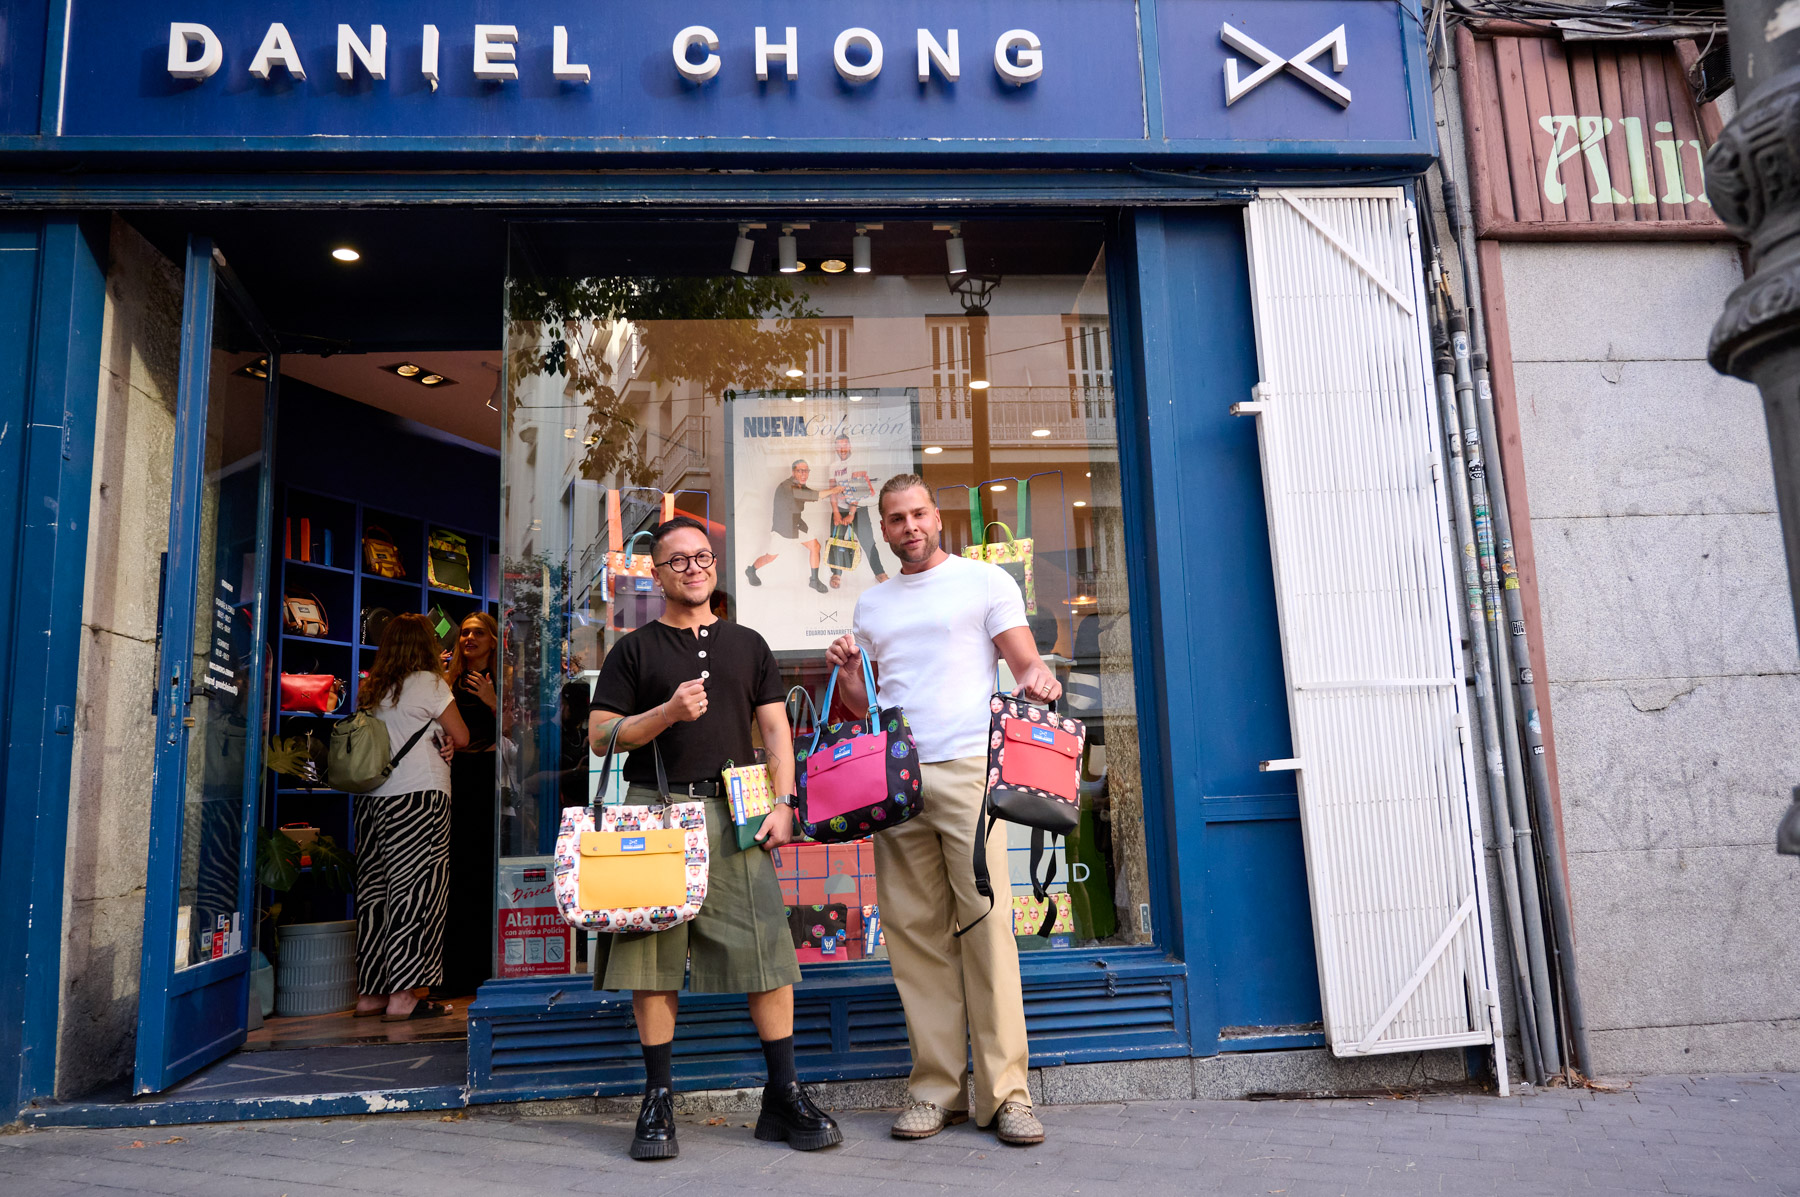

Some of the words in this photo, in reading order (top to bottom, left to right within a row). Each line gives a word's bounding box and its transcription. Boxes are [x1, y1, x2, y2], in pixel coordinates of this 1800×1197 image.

[167, 22, 591, 81] DANIEL
[672, 25, 1043, 84] CHONG
[743, 415, 807, 438] NUEVA
[804, 413, 906, 437] Colección
[805, 629, 827, 637] EDUARDO
[776, 869, 809, 878] ADRID
[512, 881, 555, 903] Direct
[505, 912, 565, 927] Alarma
